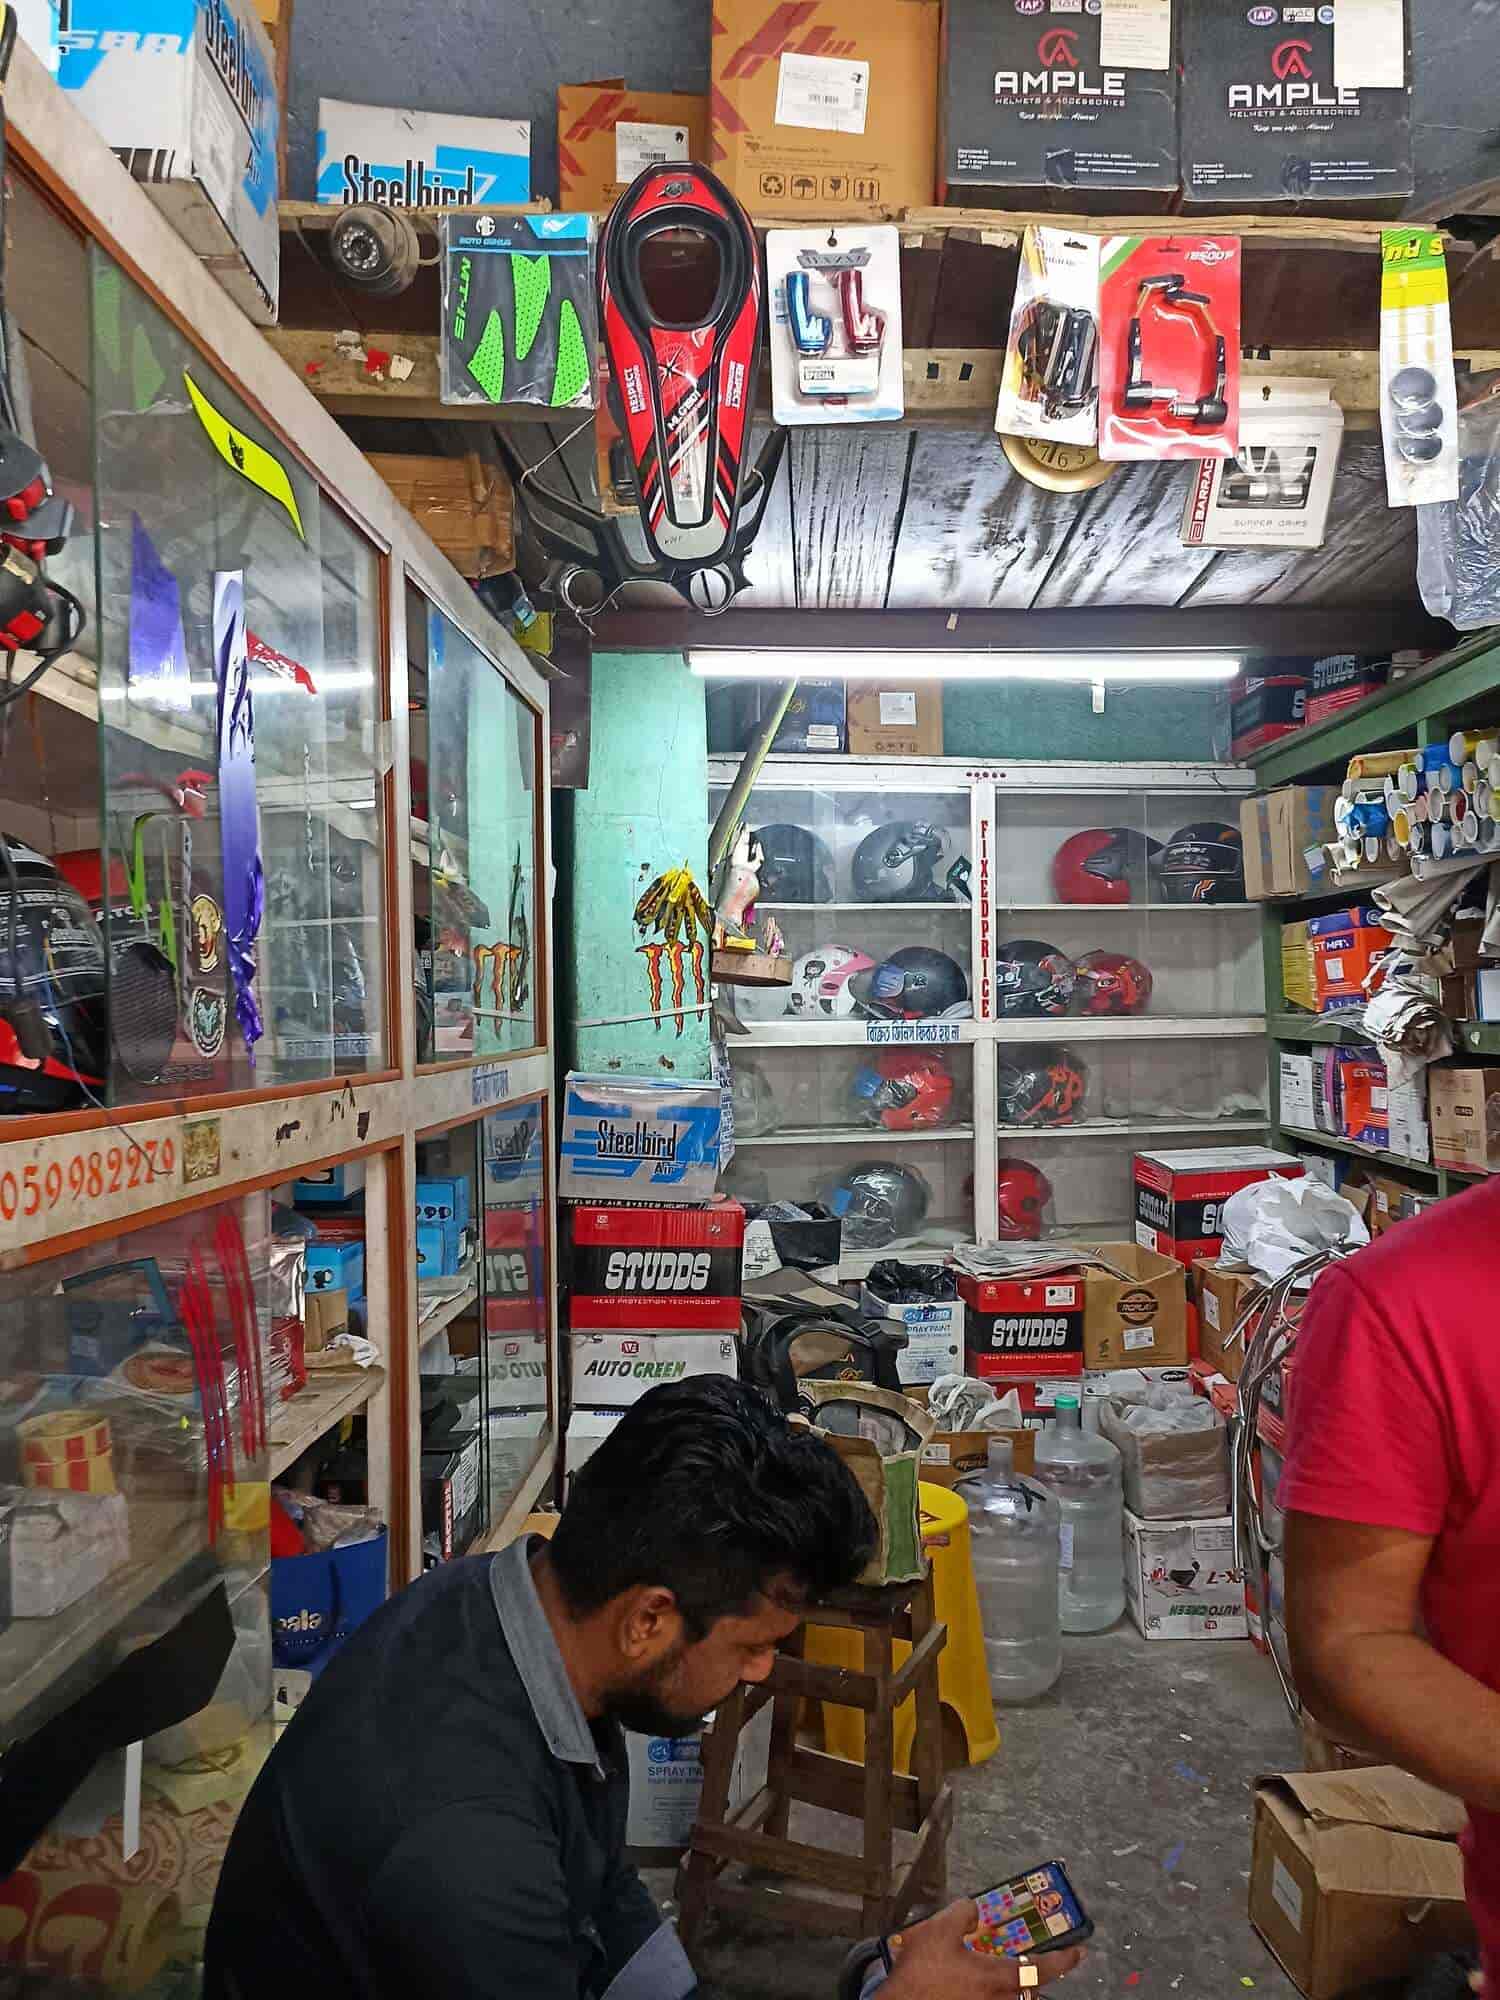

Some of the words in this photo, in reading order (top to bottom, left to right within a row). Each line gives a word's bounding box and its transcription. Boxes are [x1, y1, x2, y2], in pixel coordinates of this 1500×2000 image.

[994, 71, 1126, 96] AMPLE
[1228, 82, 1360, 107] AMPLE
[995, 97, 1041, 105] HELMETS
[1055, 97, 1126, 106] ACCESSORIES
[1229, 110, 1276, 118] HELMETS
[1290, 109, 1361, 117] ACCESSORIES
[343, 154, 474, 206] Steelbird
[598, 1119, 677, 1159] Steelbird
[604, 1251, 712, 1290] STUDDS
[991, 1318, 1068, 1347] STUDDS
[584, 1360, 632, 1377] AUTO
[633, 1361, 686, 1379] GREEN
[648, 1766, 685, 1777] SPRAY
